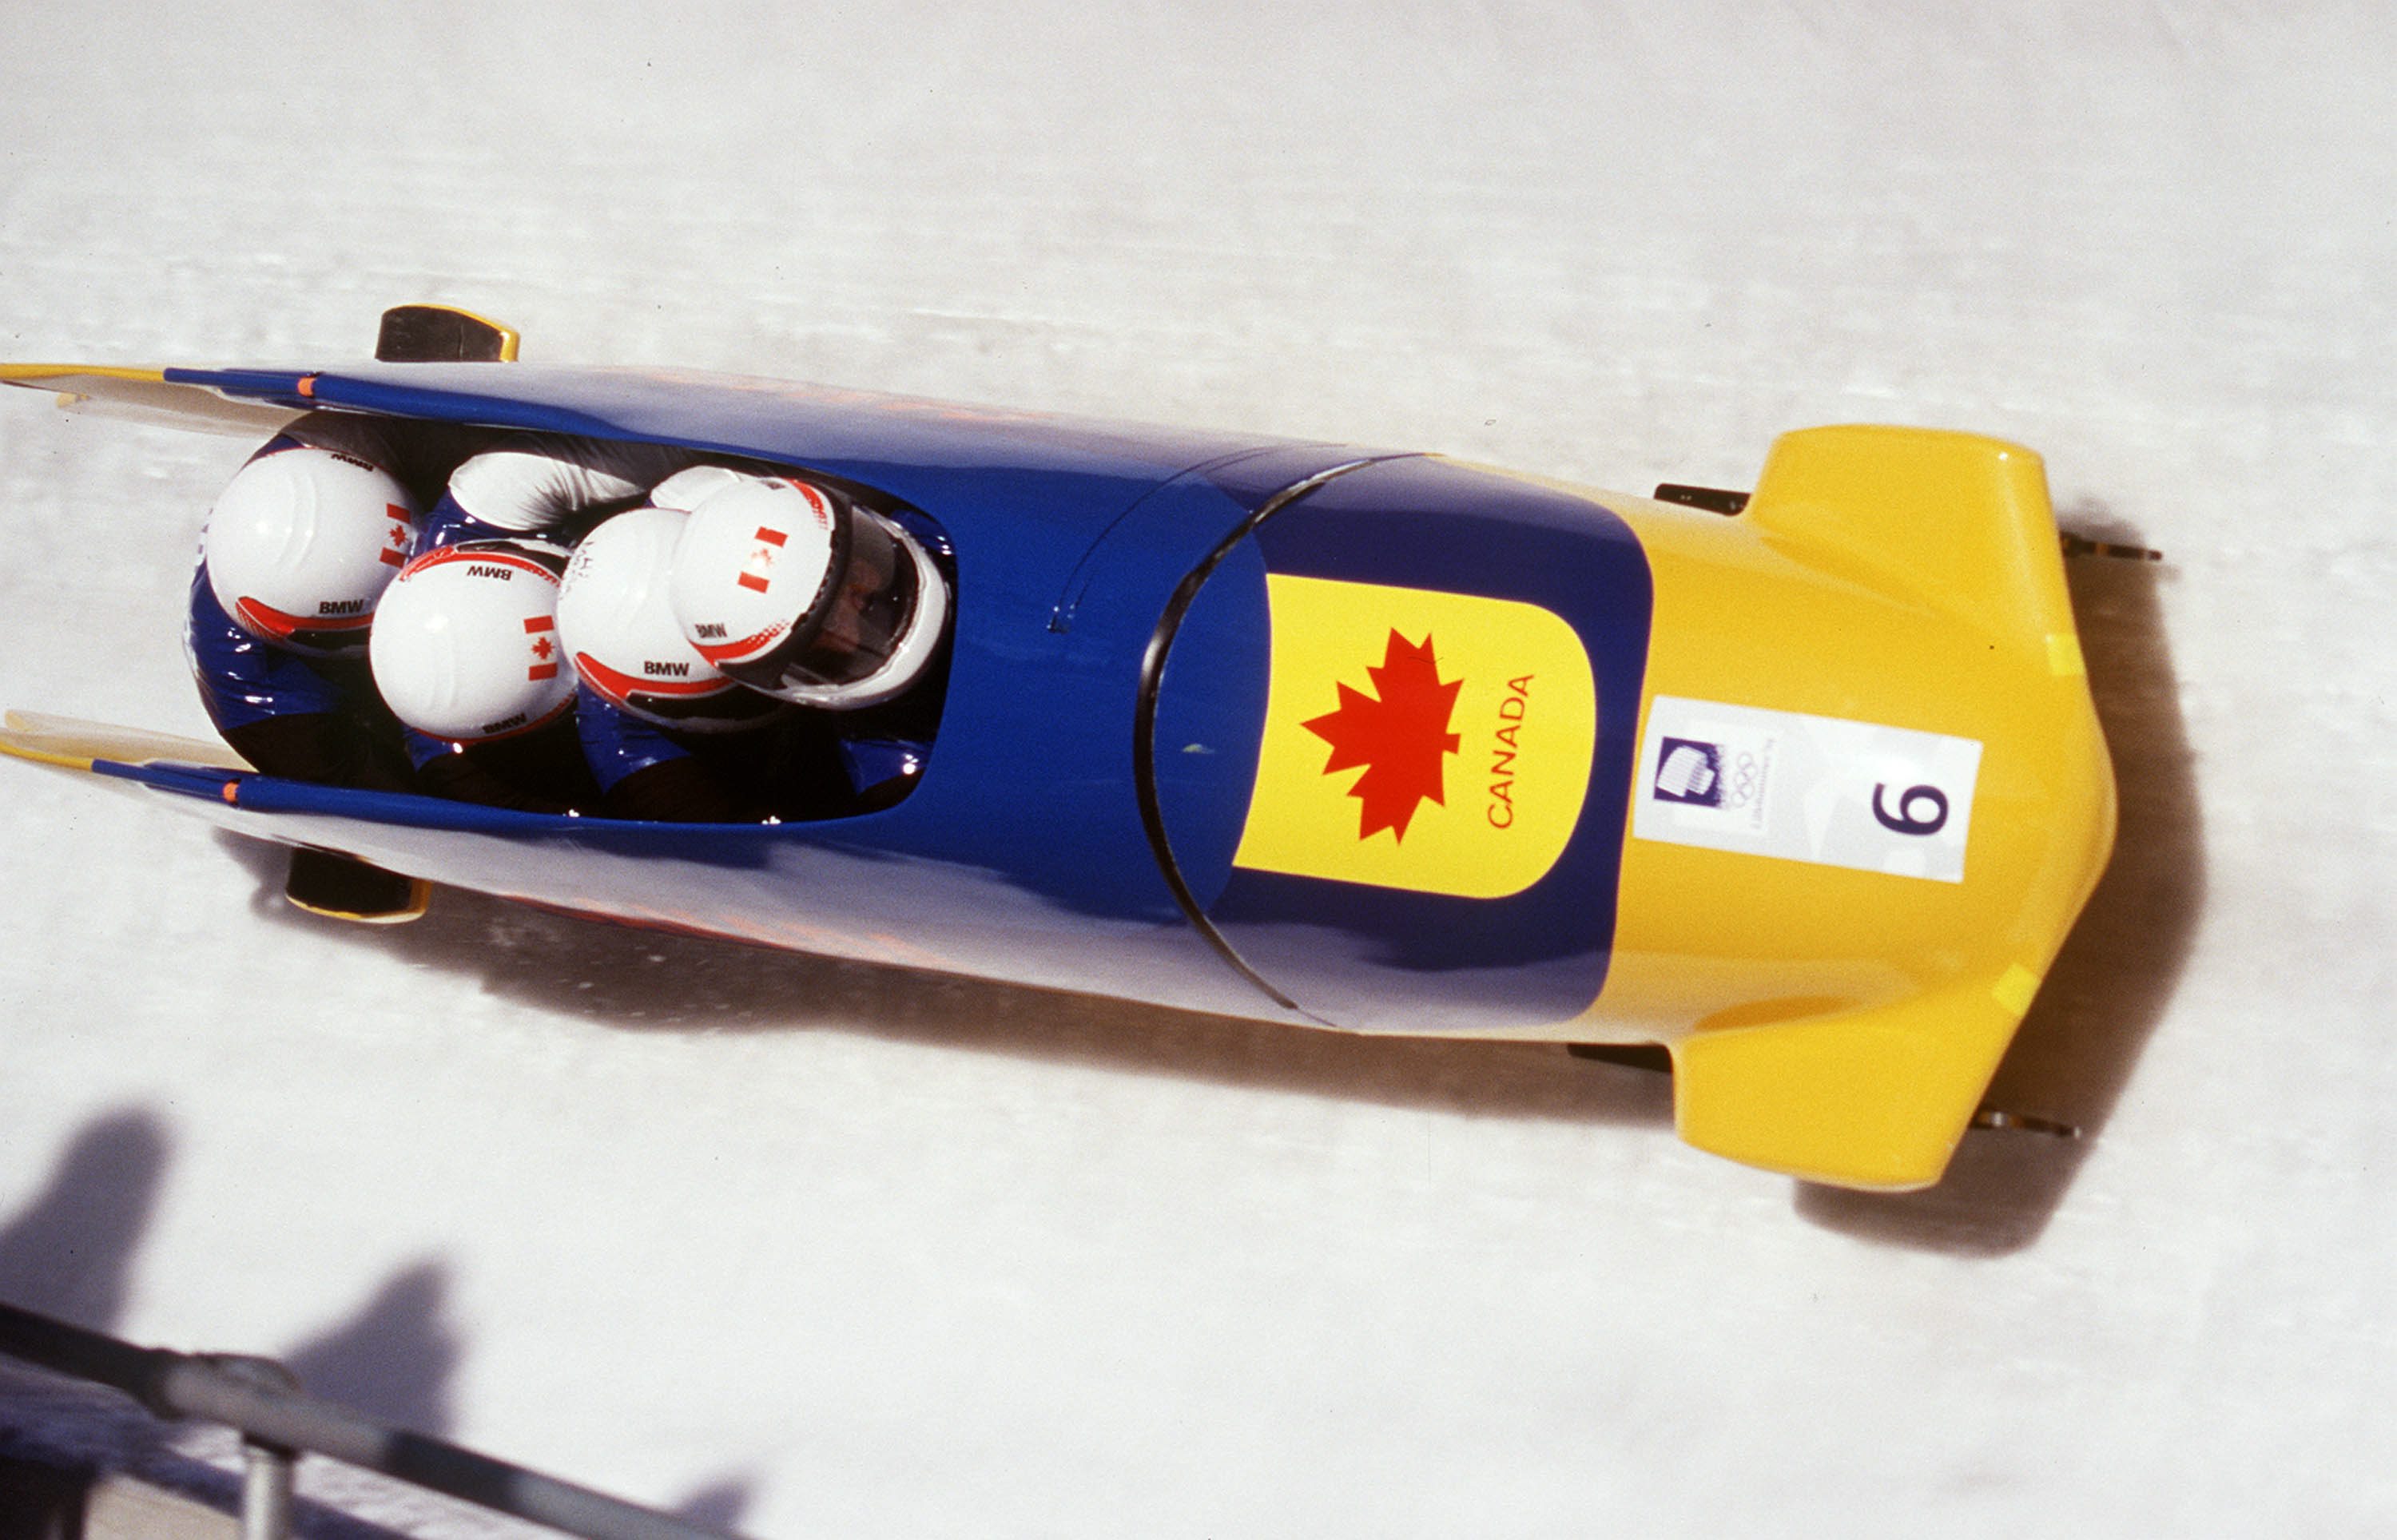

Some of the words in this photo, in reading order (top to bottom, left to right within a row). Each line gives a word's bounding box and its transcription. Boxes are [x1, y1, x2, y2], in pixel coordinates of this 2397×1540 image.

[467, 565, 512, 581] BMW
[320, 599, 364, 614] BMW
[694, 622, 727, 638] BMW
[643, 661, 690, 677] BMW
[1488, 673, 1534, 829] CANADA
[1871, 782, 1950, 836] 6
